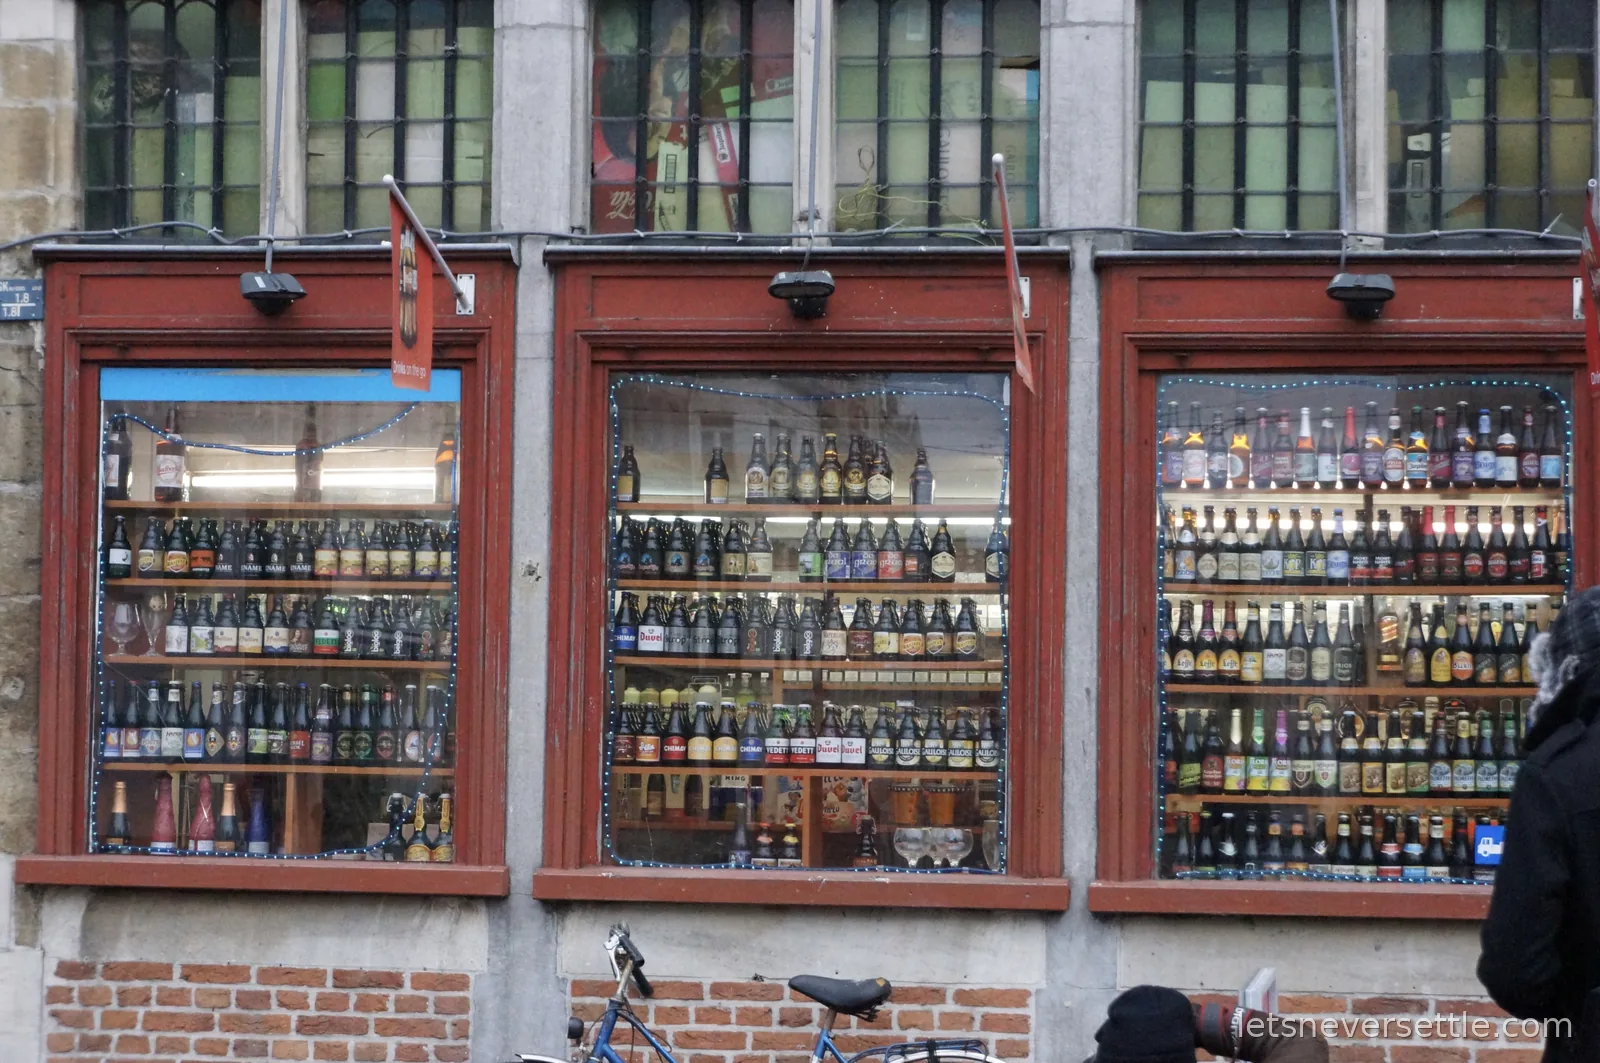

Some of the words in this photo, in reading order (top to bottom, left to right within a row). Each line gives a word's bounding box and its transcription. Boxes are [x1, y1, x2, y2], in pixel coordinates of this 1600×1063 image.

[15, 292, 30, 303] 1.8
[393, 360, 406, 374] Drinks
[406, 365, 412, 376] on
[412, 364, 420, 376] the
[420, 367, 427, 379] go
[640, 631, 663, 642] Duvel
[817, 743, 839, 753] Duvel
